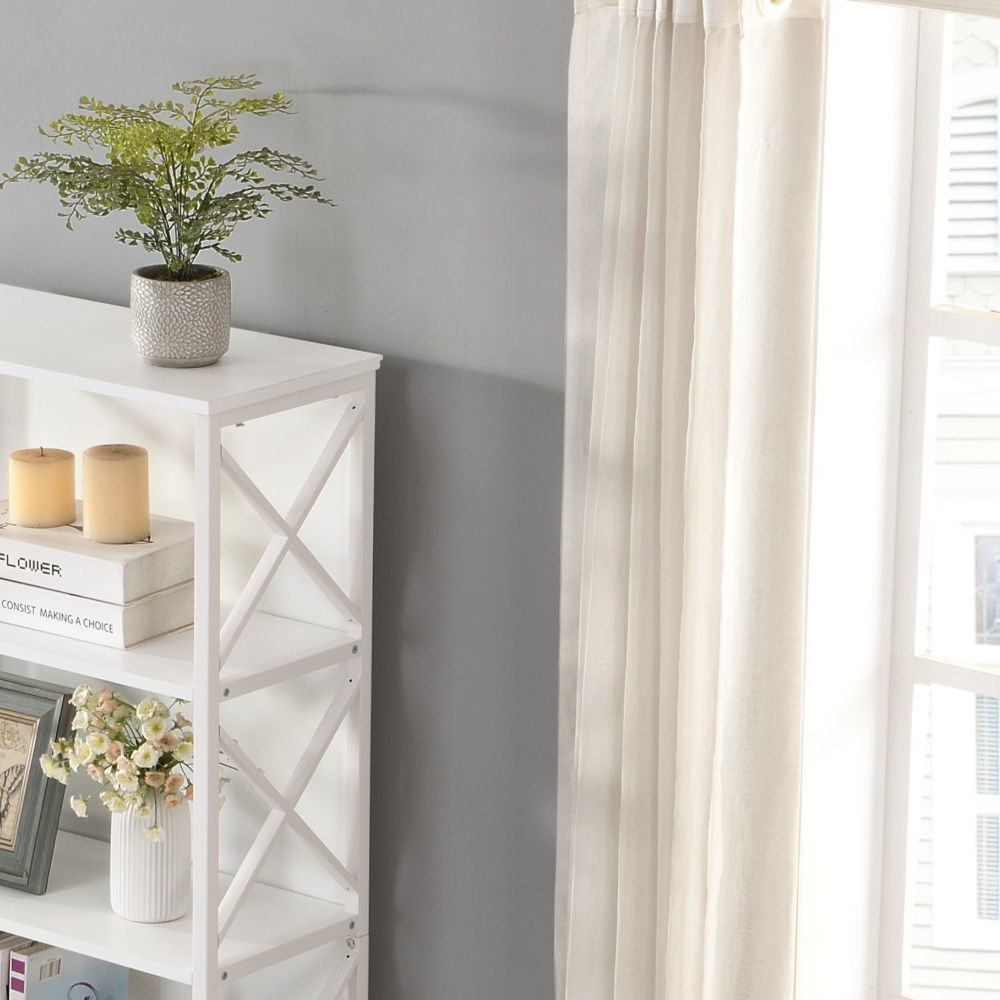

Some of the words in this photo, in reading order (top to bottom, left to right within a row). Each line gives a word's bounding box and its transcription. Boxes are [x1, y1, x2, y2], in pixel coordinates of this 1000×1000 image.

[1, 599, 36, 615] CONSIST
[39, 607, 74, 624] MAKING
[75, 616, 82, 626] A
[83, 618, 114, 634] CHOICE
